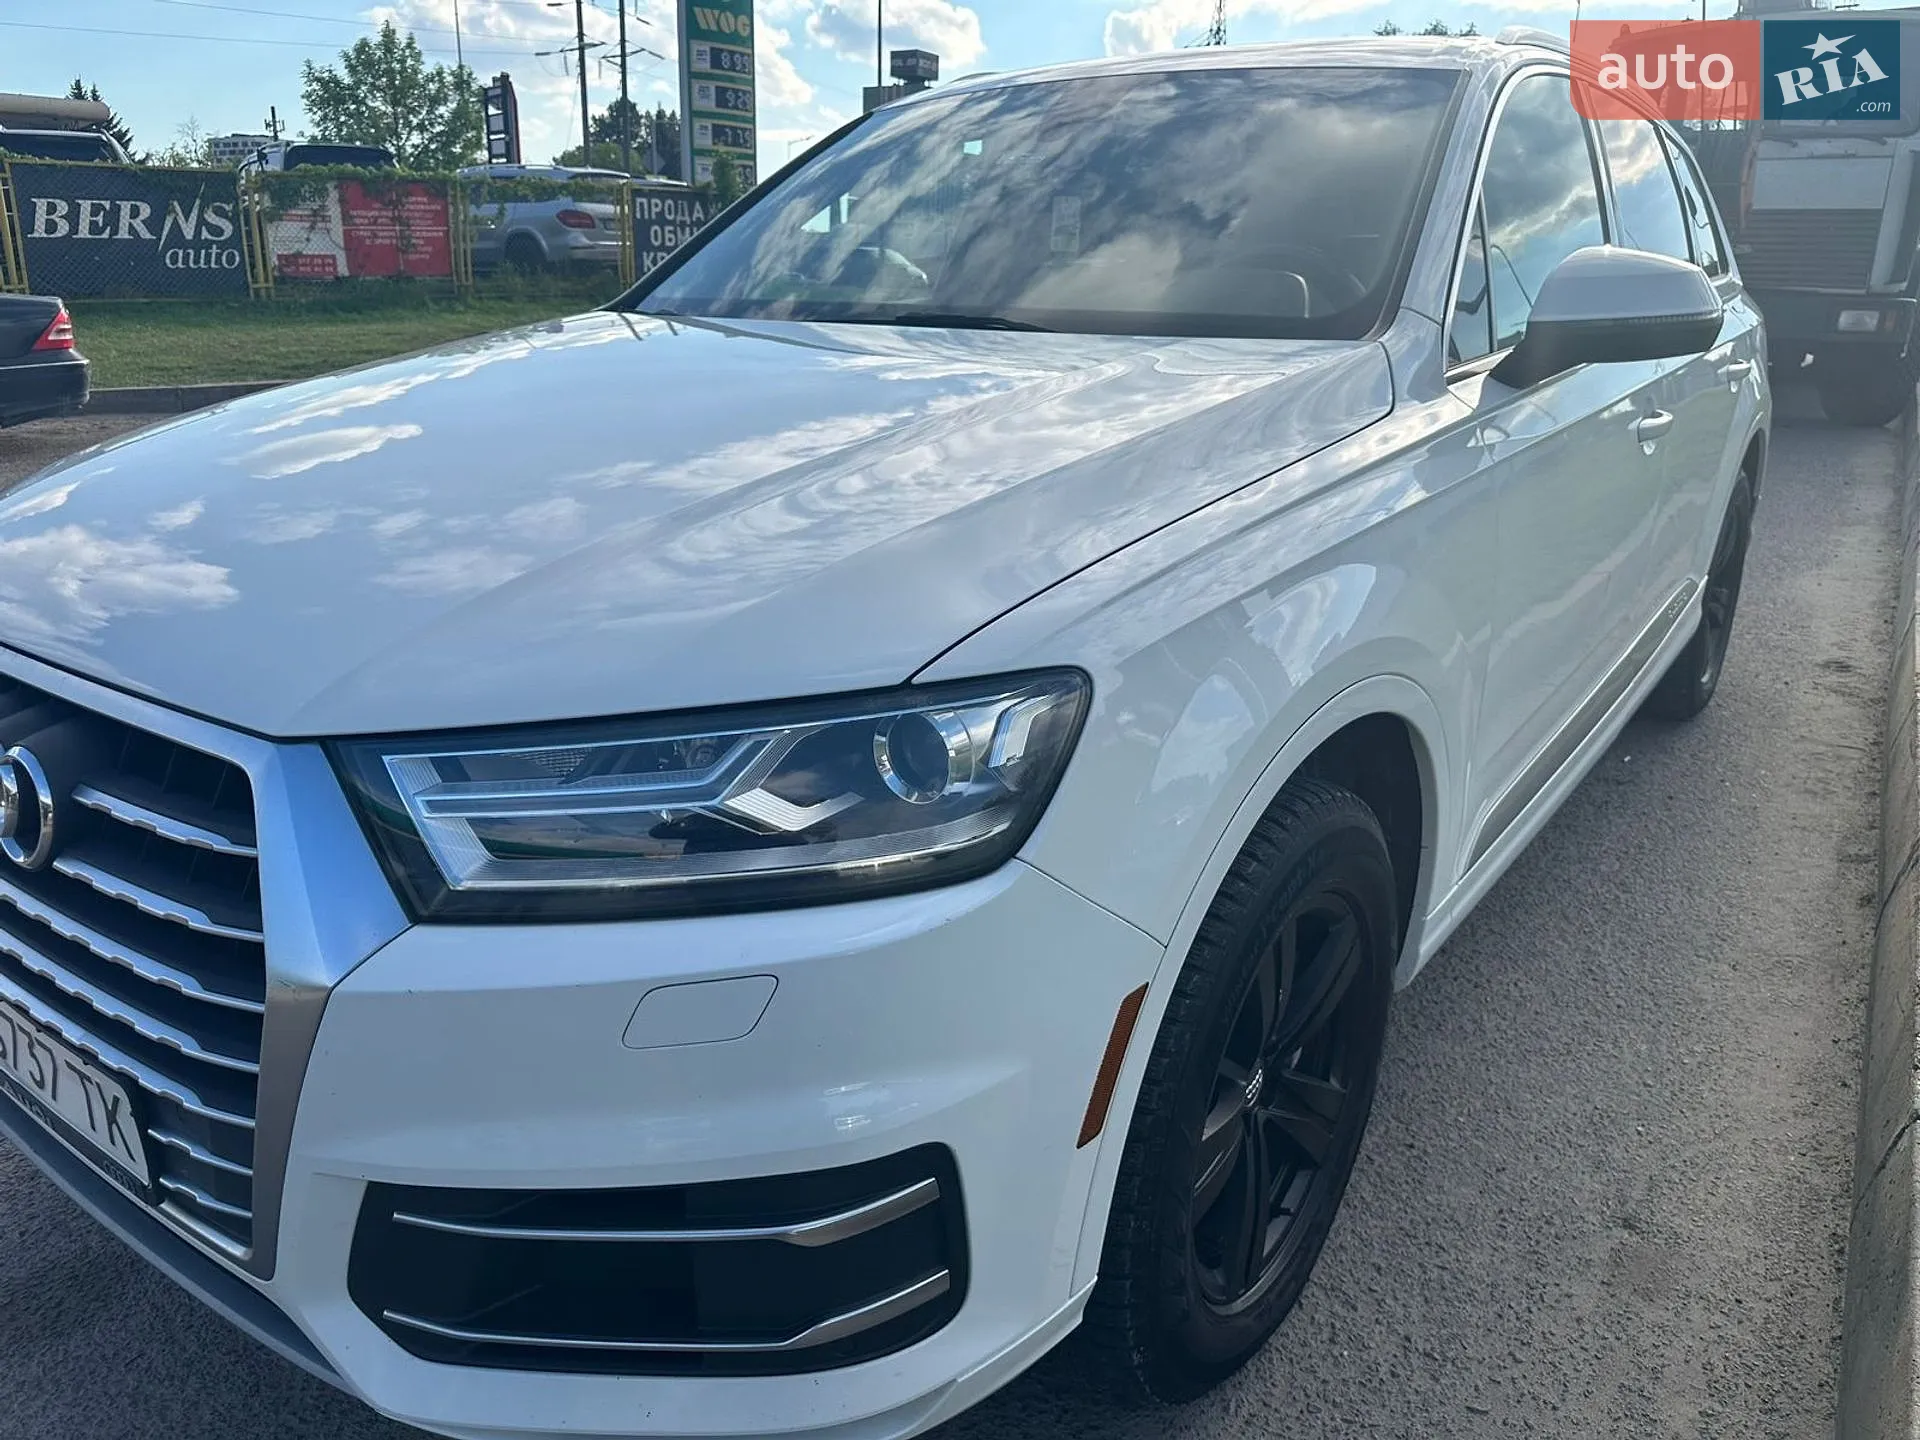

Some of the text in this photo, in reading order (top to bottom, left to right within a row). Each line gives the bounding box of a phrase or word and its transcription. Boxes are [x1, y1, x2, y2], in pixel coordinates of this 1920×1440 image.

[27, 182, 233, 250] BERNS
[650, 225, 698, 247] ОБМ
[165, 245, 240, 269] auto
[64, 1059, 136, 1163] TK
